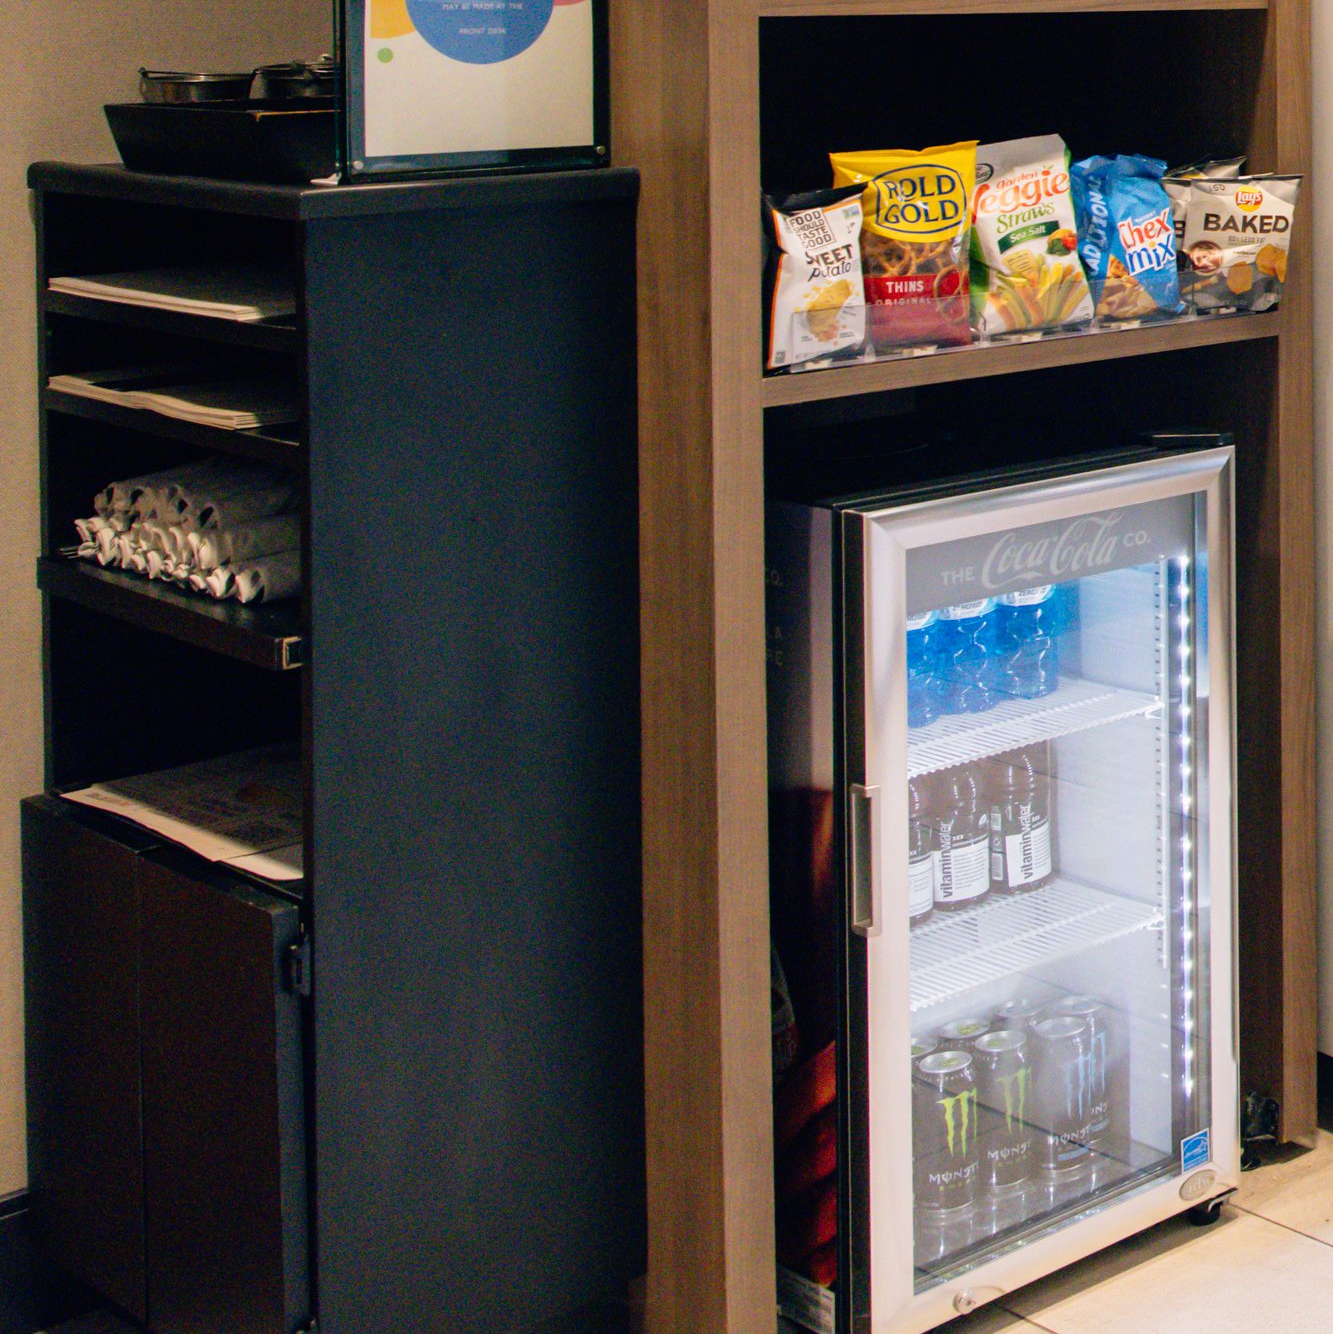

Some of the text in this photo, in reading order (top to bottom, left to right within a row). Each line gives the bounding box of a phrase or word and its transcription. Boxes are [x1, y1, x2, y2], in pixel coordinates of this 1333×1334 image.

[883, 174, 956, 204] ROLD
[995, 171, 1039, 190] Garden
[1236, 190, 1262, 206] Lay's
[789, 210, 821, 228] FOOD
[883, 200, 960, 225] GOLD
[996, 201, 1056, 234] Straws
[1203, 212, 1290, 234] BAKED
[797, 226, 829, 242] TASTE
[1010, 225, 1046, 243] Sea Salt
[1117, 210, 1171, 250] Chex
[1127, 233, 1175, 274] mix
[886, 280, 925, 294] THINS
[875, 296, 932, 307] ORIGINAL
[941, 567, 975, 587] THE
[1123, 529, 1151, 548] CO.
[1020, 800, 1034, 880] vitaminwater
[939, 818, 954, 899] vitaminwater
